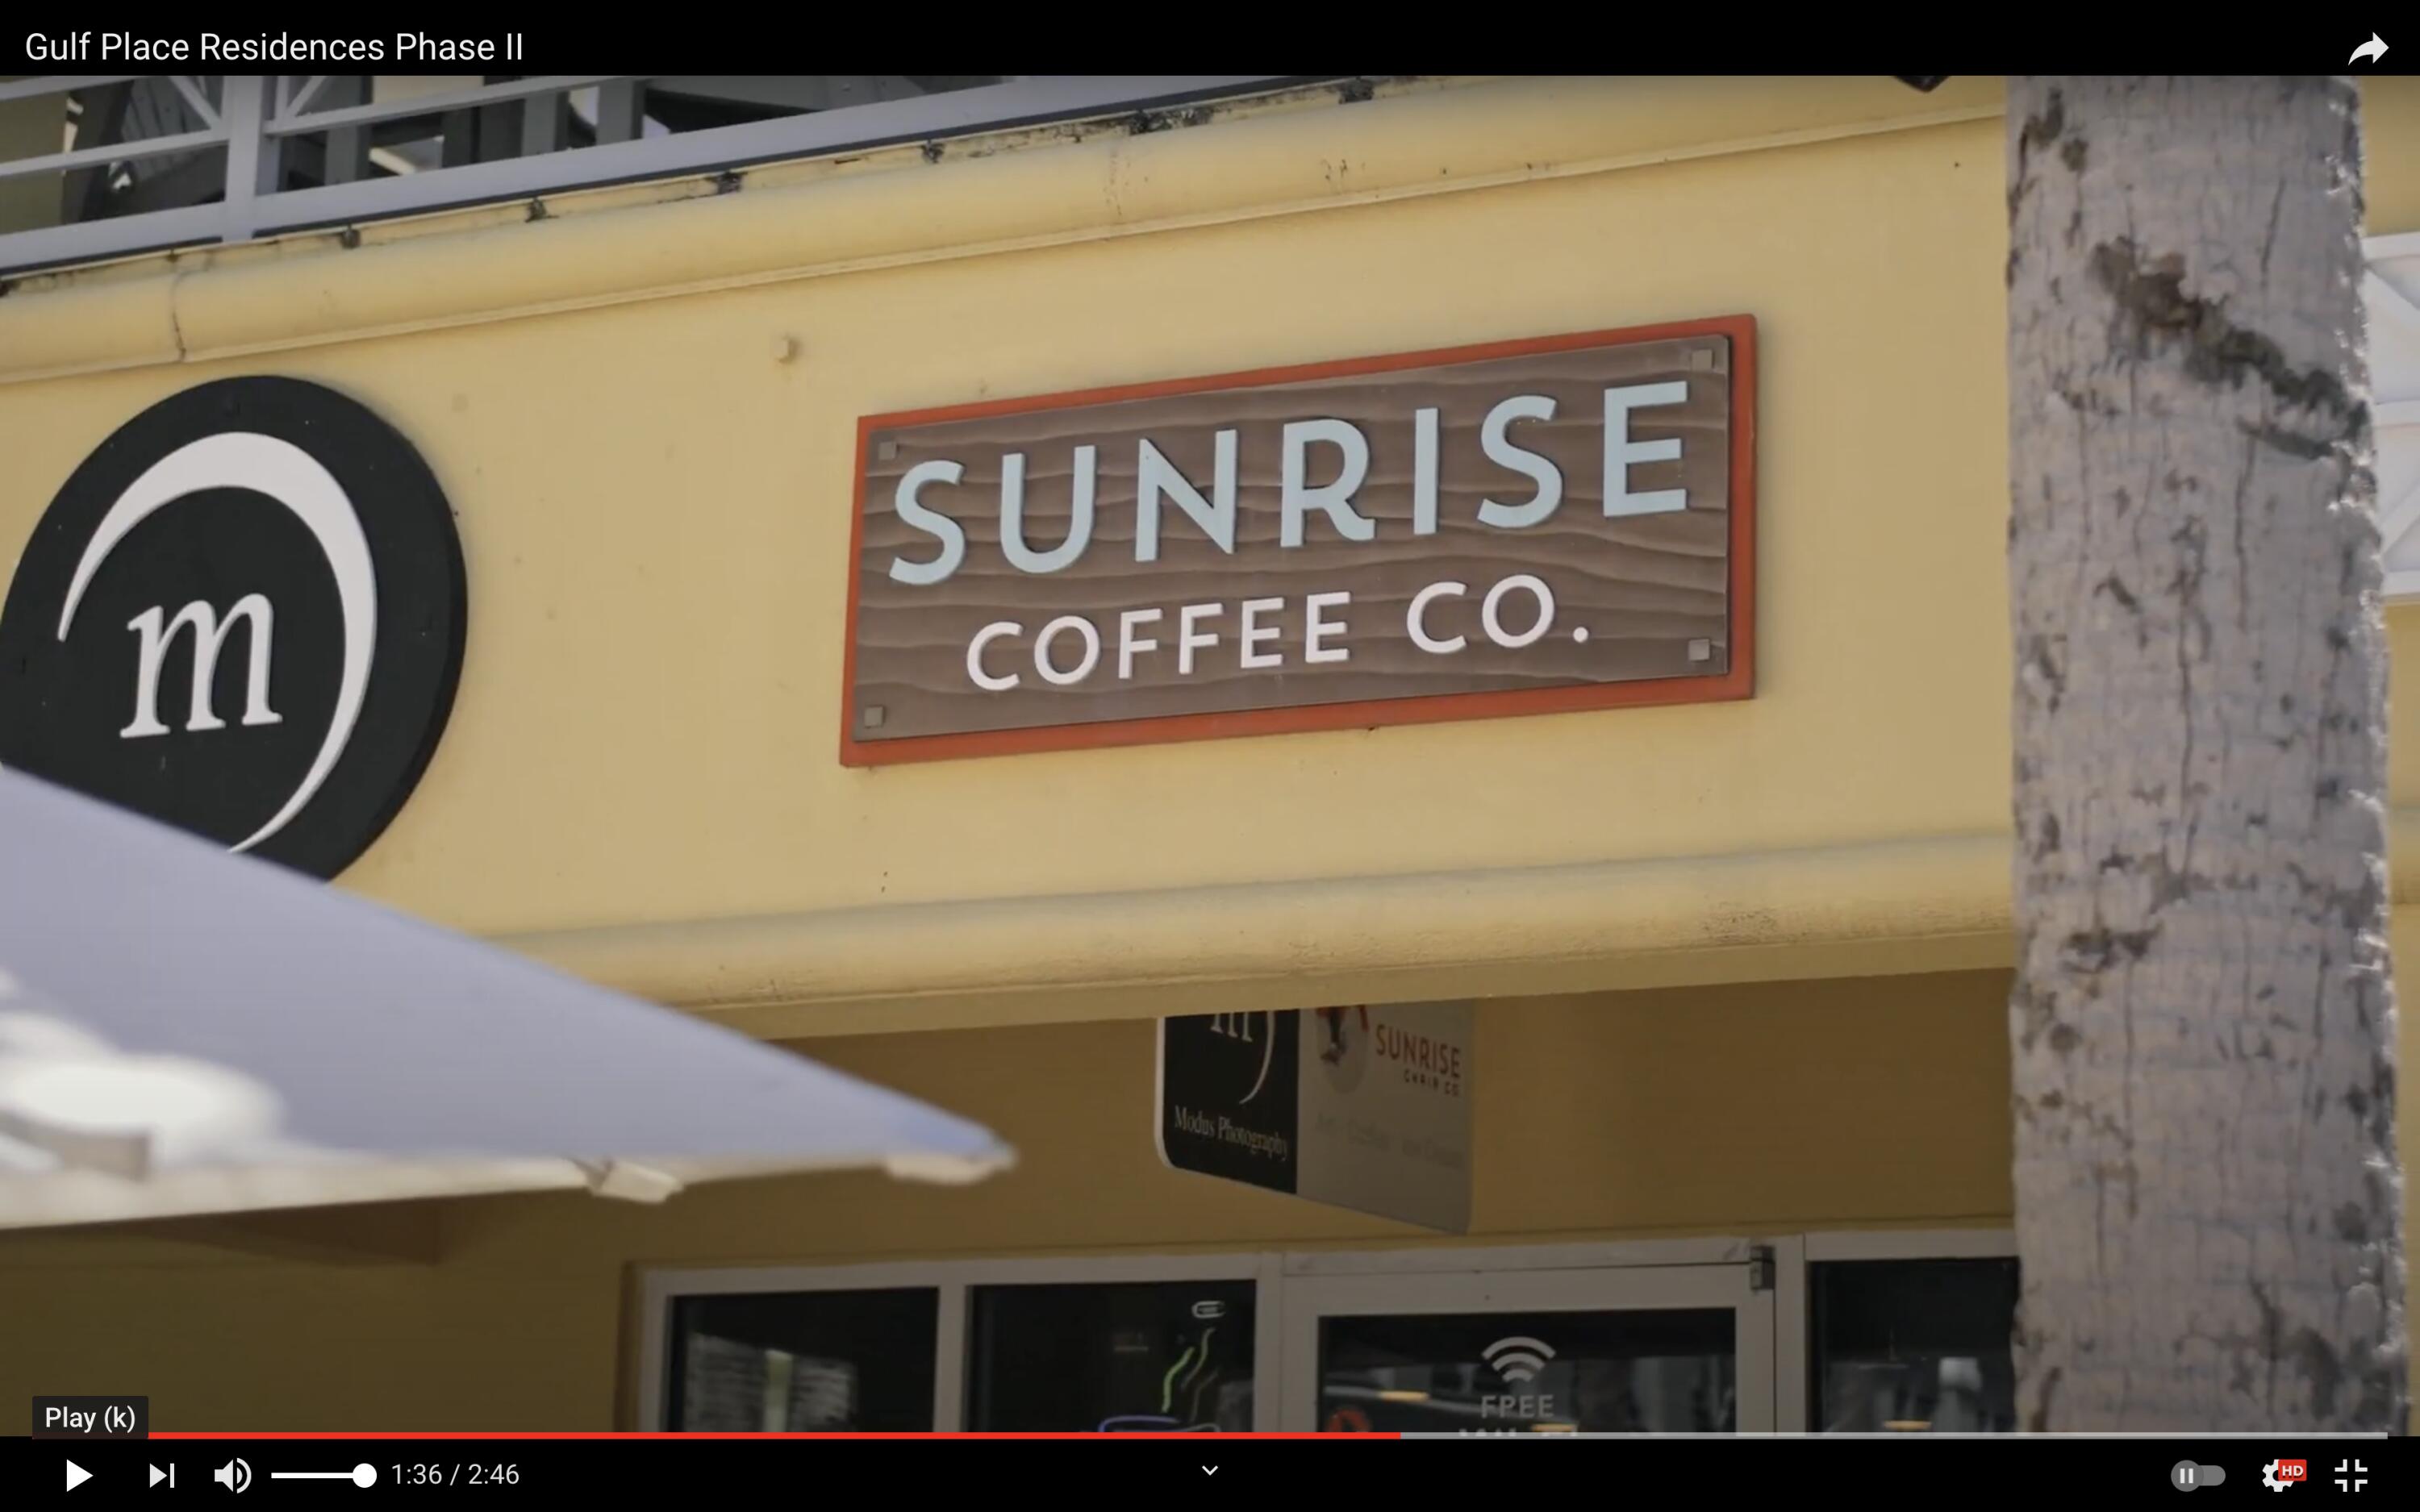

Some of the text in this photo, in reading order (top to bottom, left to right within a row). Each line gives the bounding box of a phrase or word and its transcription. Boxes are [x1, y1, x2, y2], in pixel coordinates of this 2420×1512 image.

[888, 380, 1688, 586] SUNRISE
[119, 593, 282, 739] m
[966, 574, 1588, 691] COFFEE CO.
[1375, 1023, 1461, 1079] SUNRISE
[1404, 1068, 1439, 1090] CHAIR
[1175, 1105, 1215, 1137] Modus
[1218, 1116, 1287, 1162] Photography
